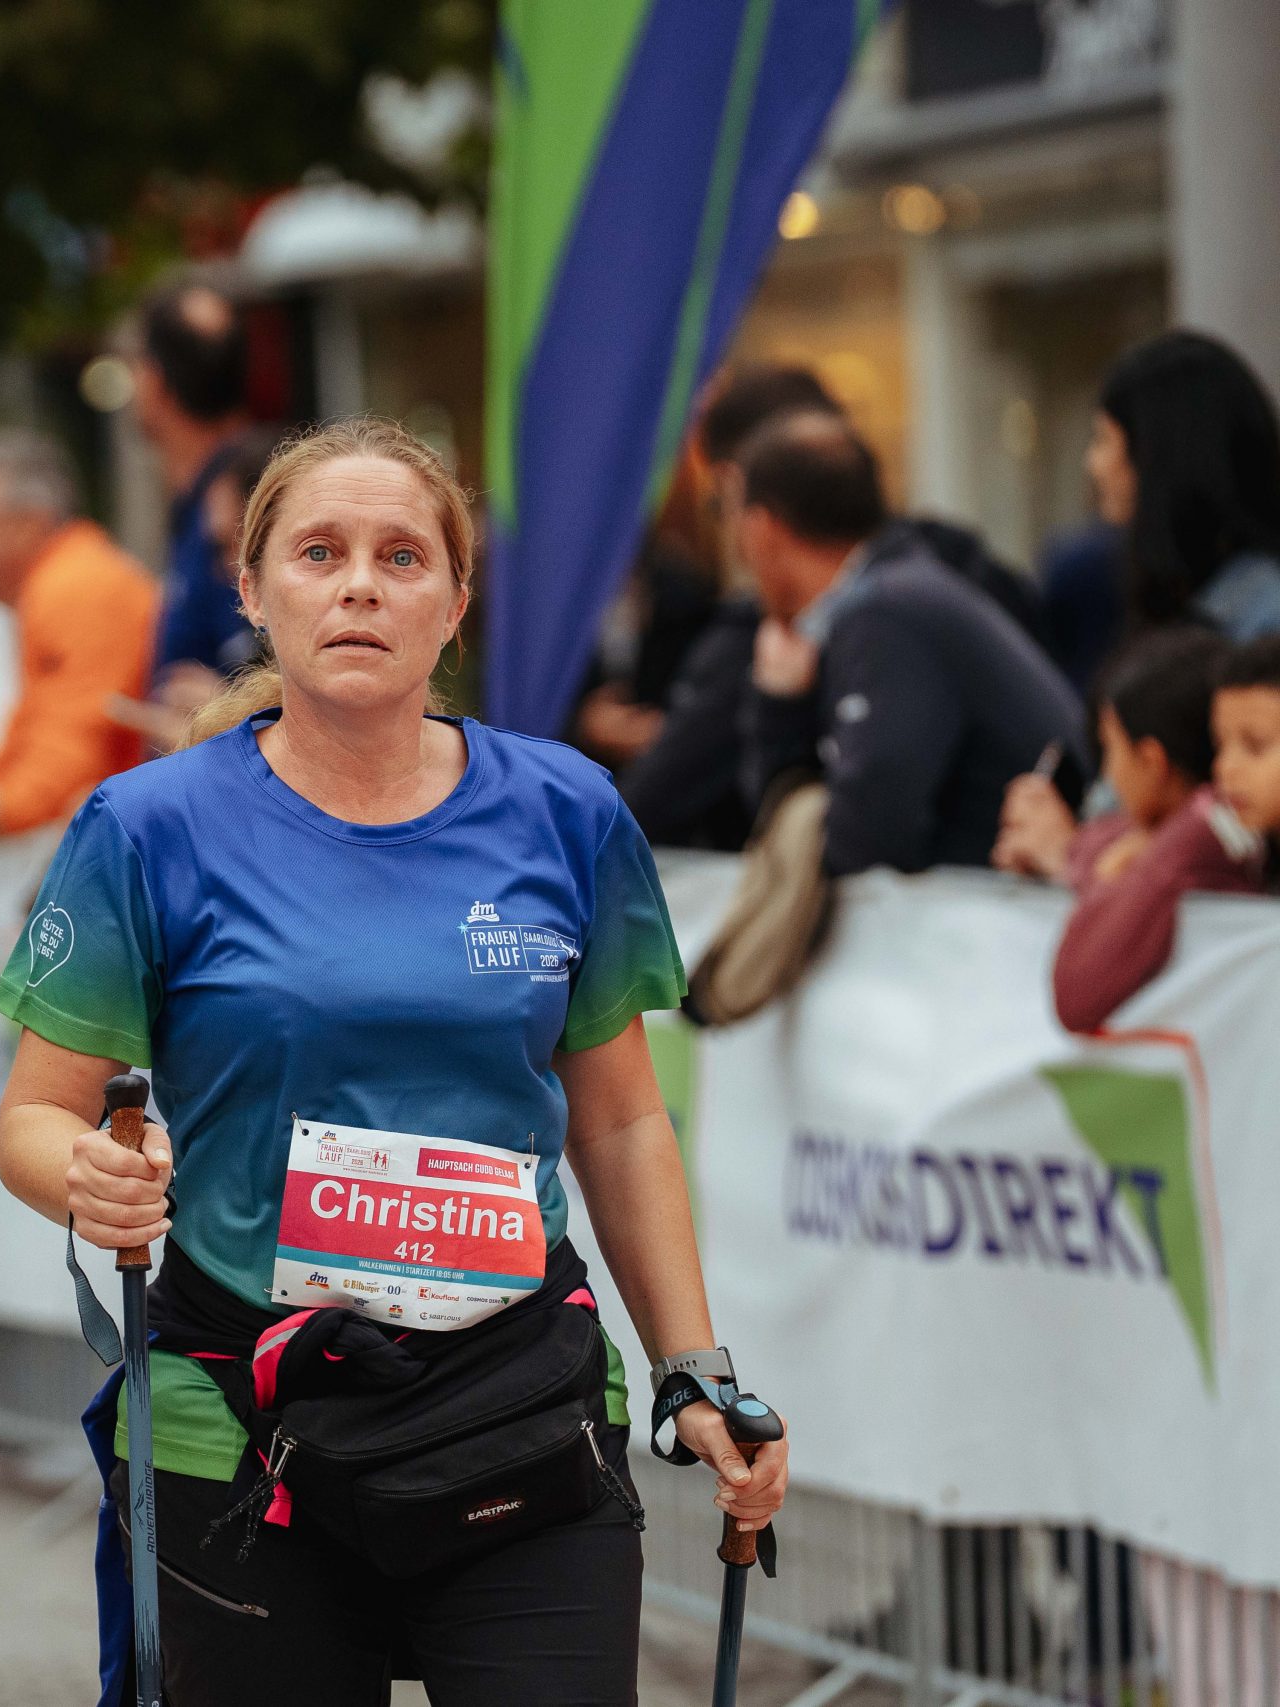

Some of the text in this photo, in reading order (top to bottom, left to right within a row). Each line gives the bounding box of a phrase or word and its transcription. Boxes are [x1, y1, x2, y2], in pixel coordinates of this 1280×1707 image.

[470, 901, 495, 915] dm
[471, 931, 518, 946] FRAUEN
[474, 948, 521, 968] LAUF
[540, 955, 559, 967] 2026
[320, 1144, 344, 1153] FRAUEN
[320, 1152, 342, 1162] LAUF
[428, 1159, 515, 1180] HAUPTSACH GUDD GELAAF
[310, 1180, 524, 1241] Christina
[394, 1241, 435, 1262] 412
[310, 1272, 328, 1284] dm
[359, 1261, 401, 1273] WALKERINNEN
[405, 1267, 436, 1277] STARTZEIT
[452, 1271, 464, 1280] UHR
[431, 1293, 460, 1302] Kaufland
[468, 1501, 519, 1520] EASTPAK
